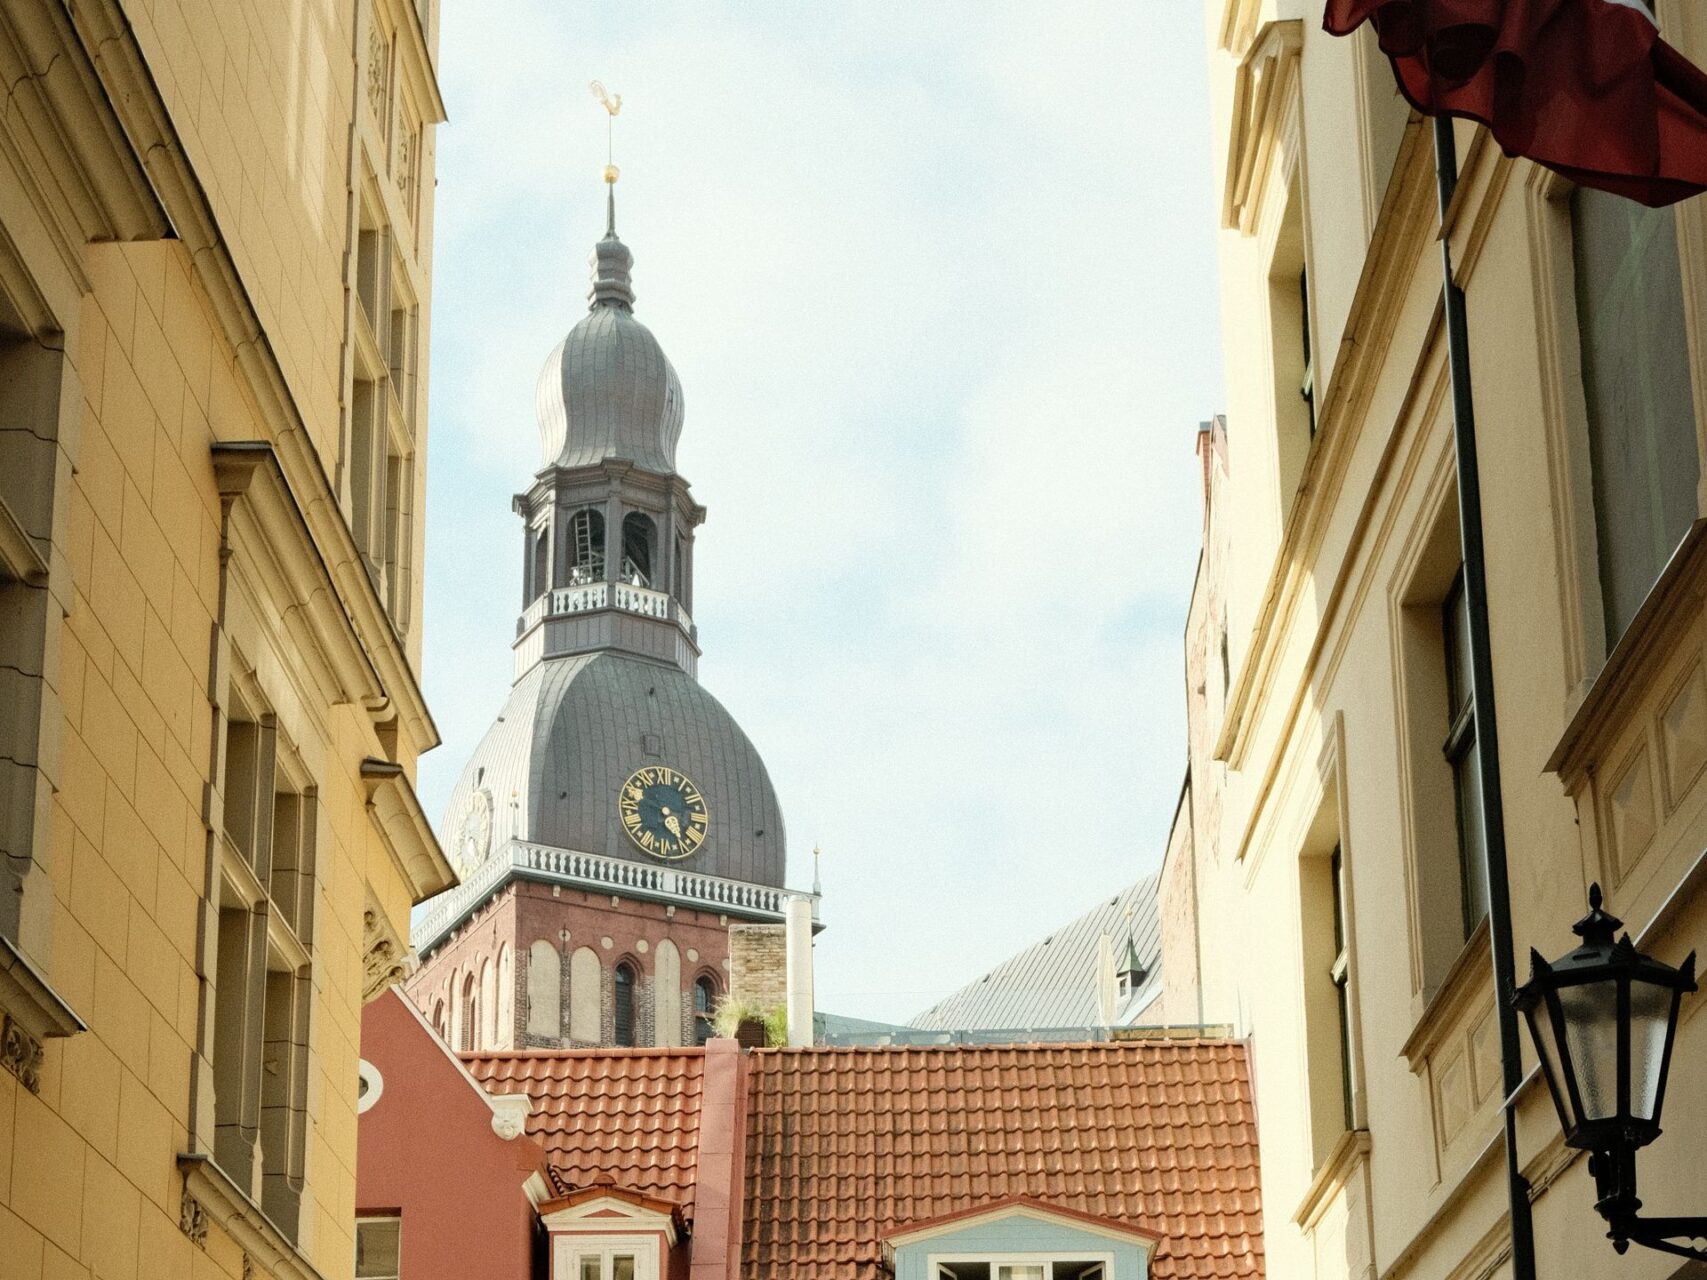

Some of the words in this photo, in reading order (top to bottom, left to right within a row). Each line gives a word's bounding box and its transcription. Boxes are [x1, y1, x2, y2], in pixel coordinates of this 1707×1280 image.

[656, 767, 671, 785] XII
[685, 793, 702, 804] II
[661, 838, 671, 855] VI
